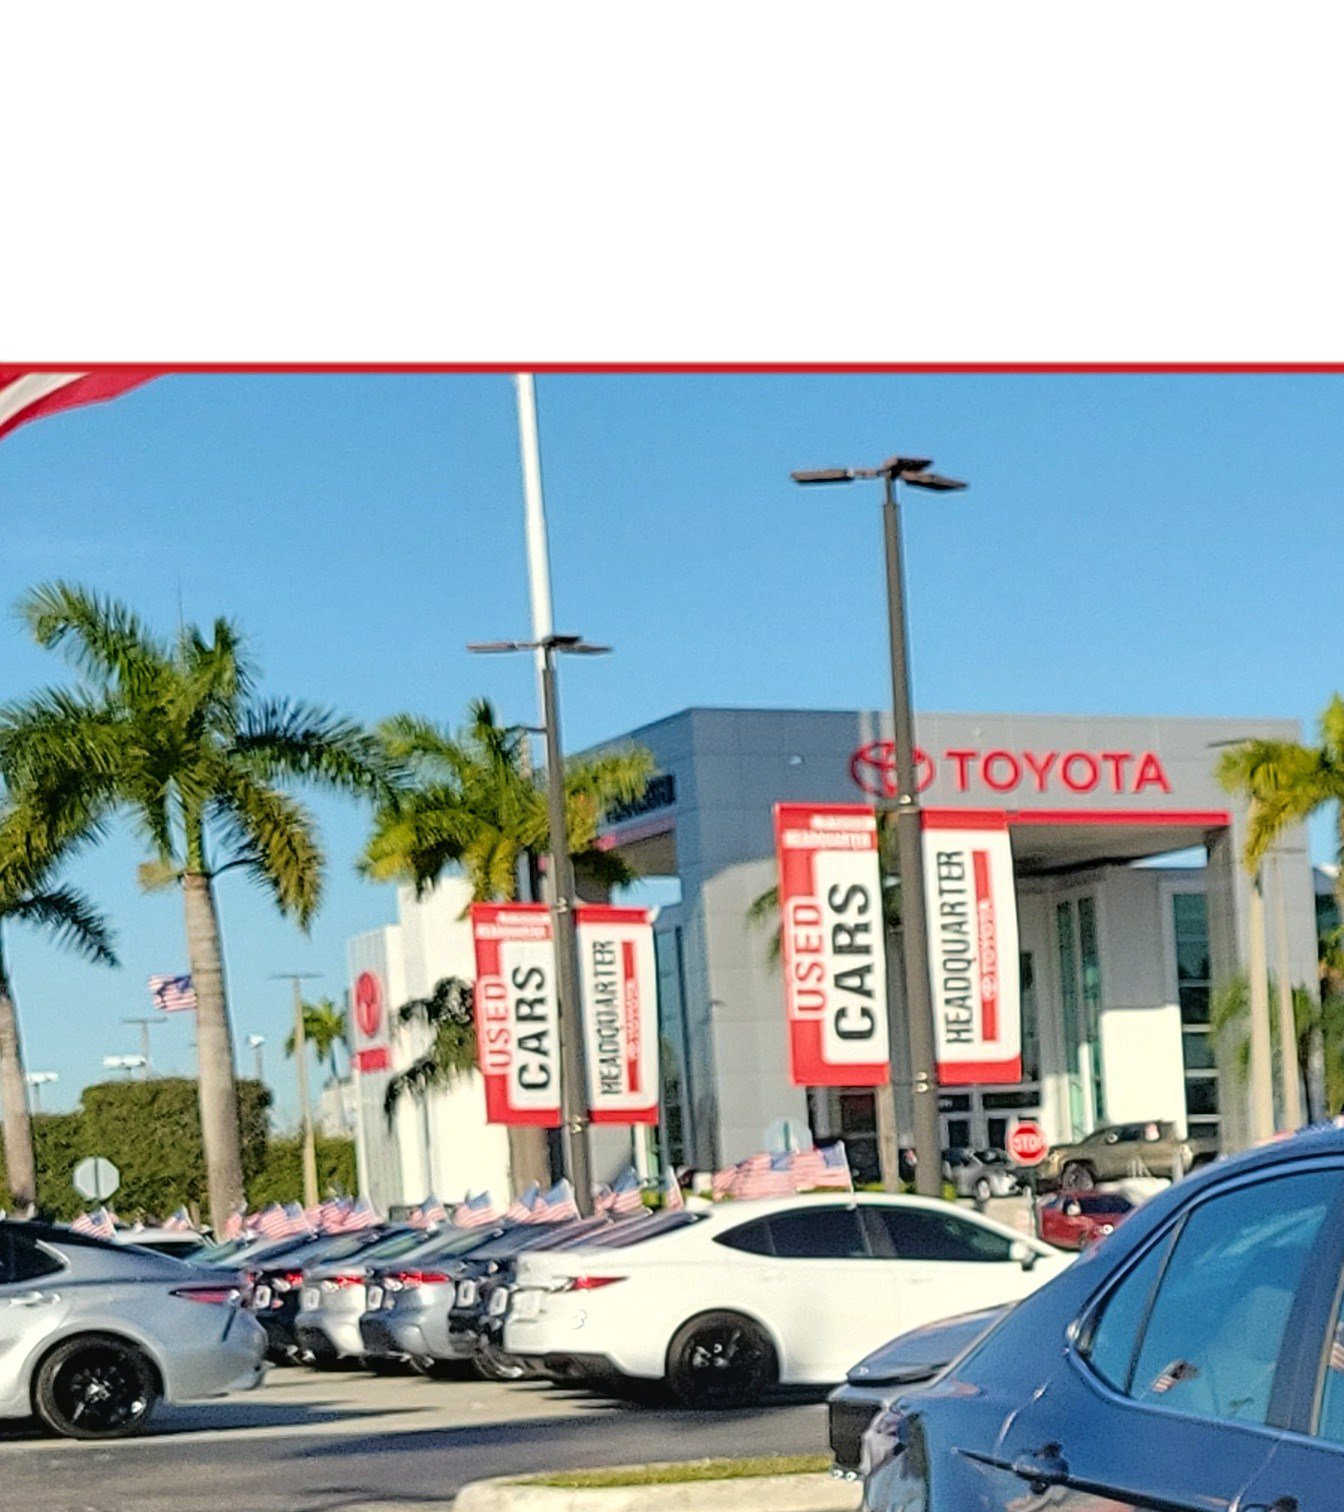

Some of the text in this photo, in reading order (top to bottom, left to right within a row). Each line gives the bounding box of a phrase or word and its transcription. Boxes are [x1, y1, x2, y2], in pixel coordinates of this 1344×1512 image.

[945, 749, 1172, 794] TOYOTA
[792, 903, 827, 1013] USED
[828, 883, 876, 1041] CARS
[936, 850, 976, 1045] HEADQUARTER
[484, 982, 514, 1069] USED
[511, 965, 551, 1091] CARS
[592, 940, 624, 1095] HEADQUARTER
